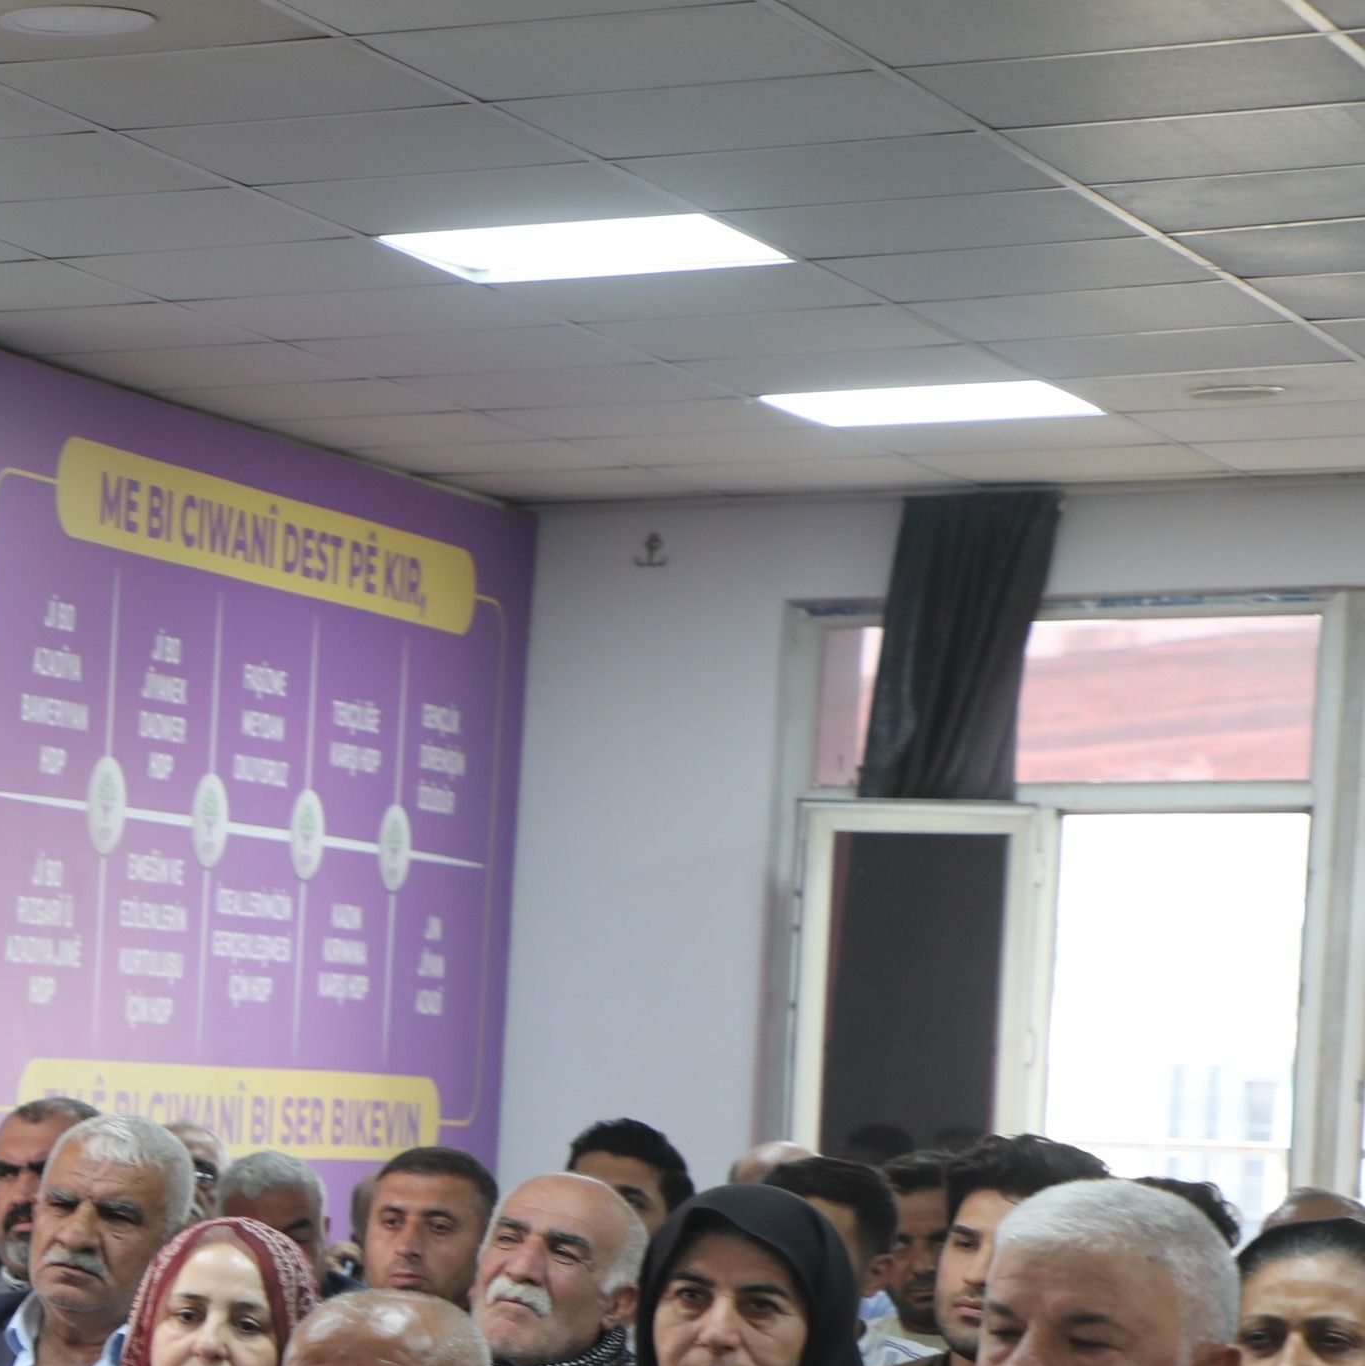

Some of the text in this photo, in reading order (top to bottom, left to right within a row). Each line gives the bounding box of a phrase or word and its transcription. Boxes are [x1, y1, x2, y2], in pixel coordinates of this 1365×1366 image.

[99, 470, 141, 534] ME
[147, 484, 174, 543] BI
[180, 494, 278, 569] CIWANÎ
[282, 522, 344, 585] DEST
[348, 531, 379, 594] PÊ
[250, 1096, 275, 1145] BI
[280, 1097, 325, 1145] SER
[331, 1098, 422, 1147] BIKEVIN
